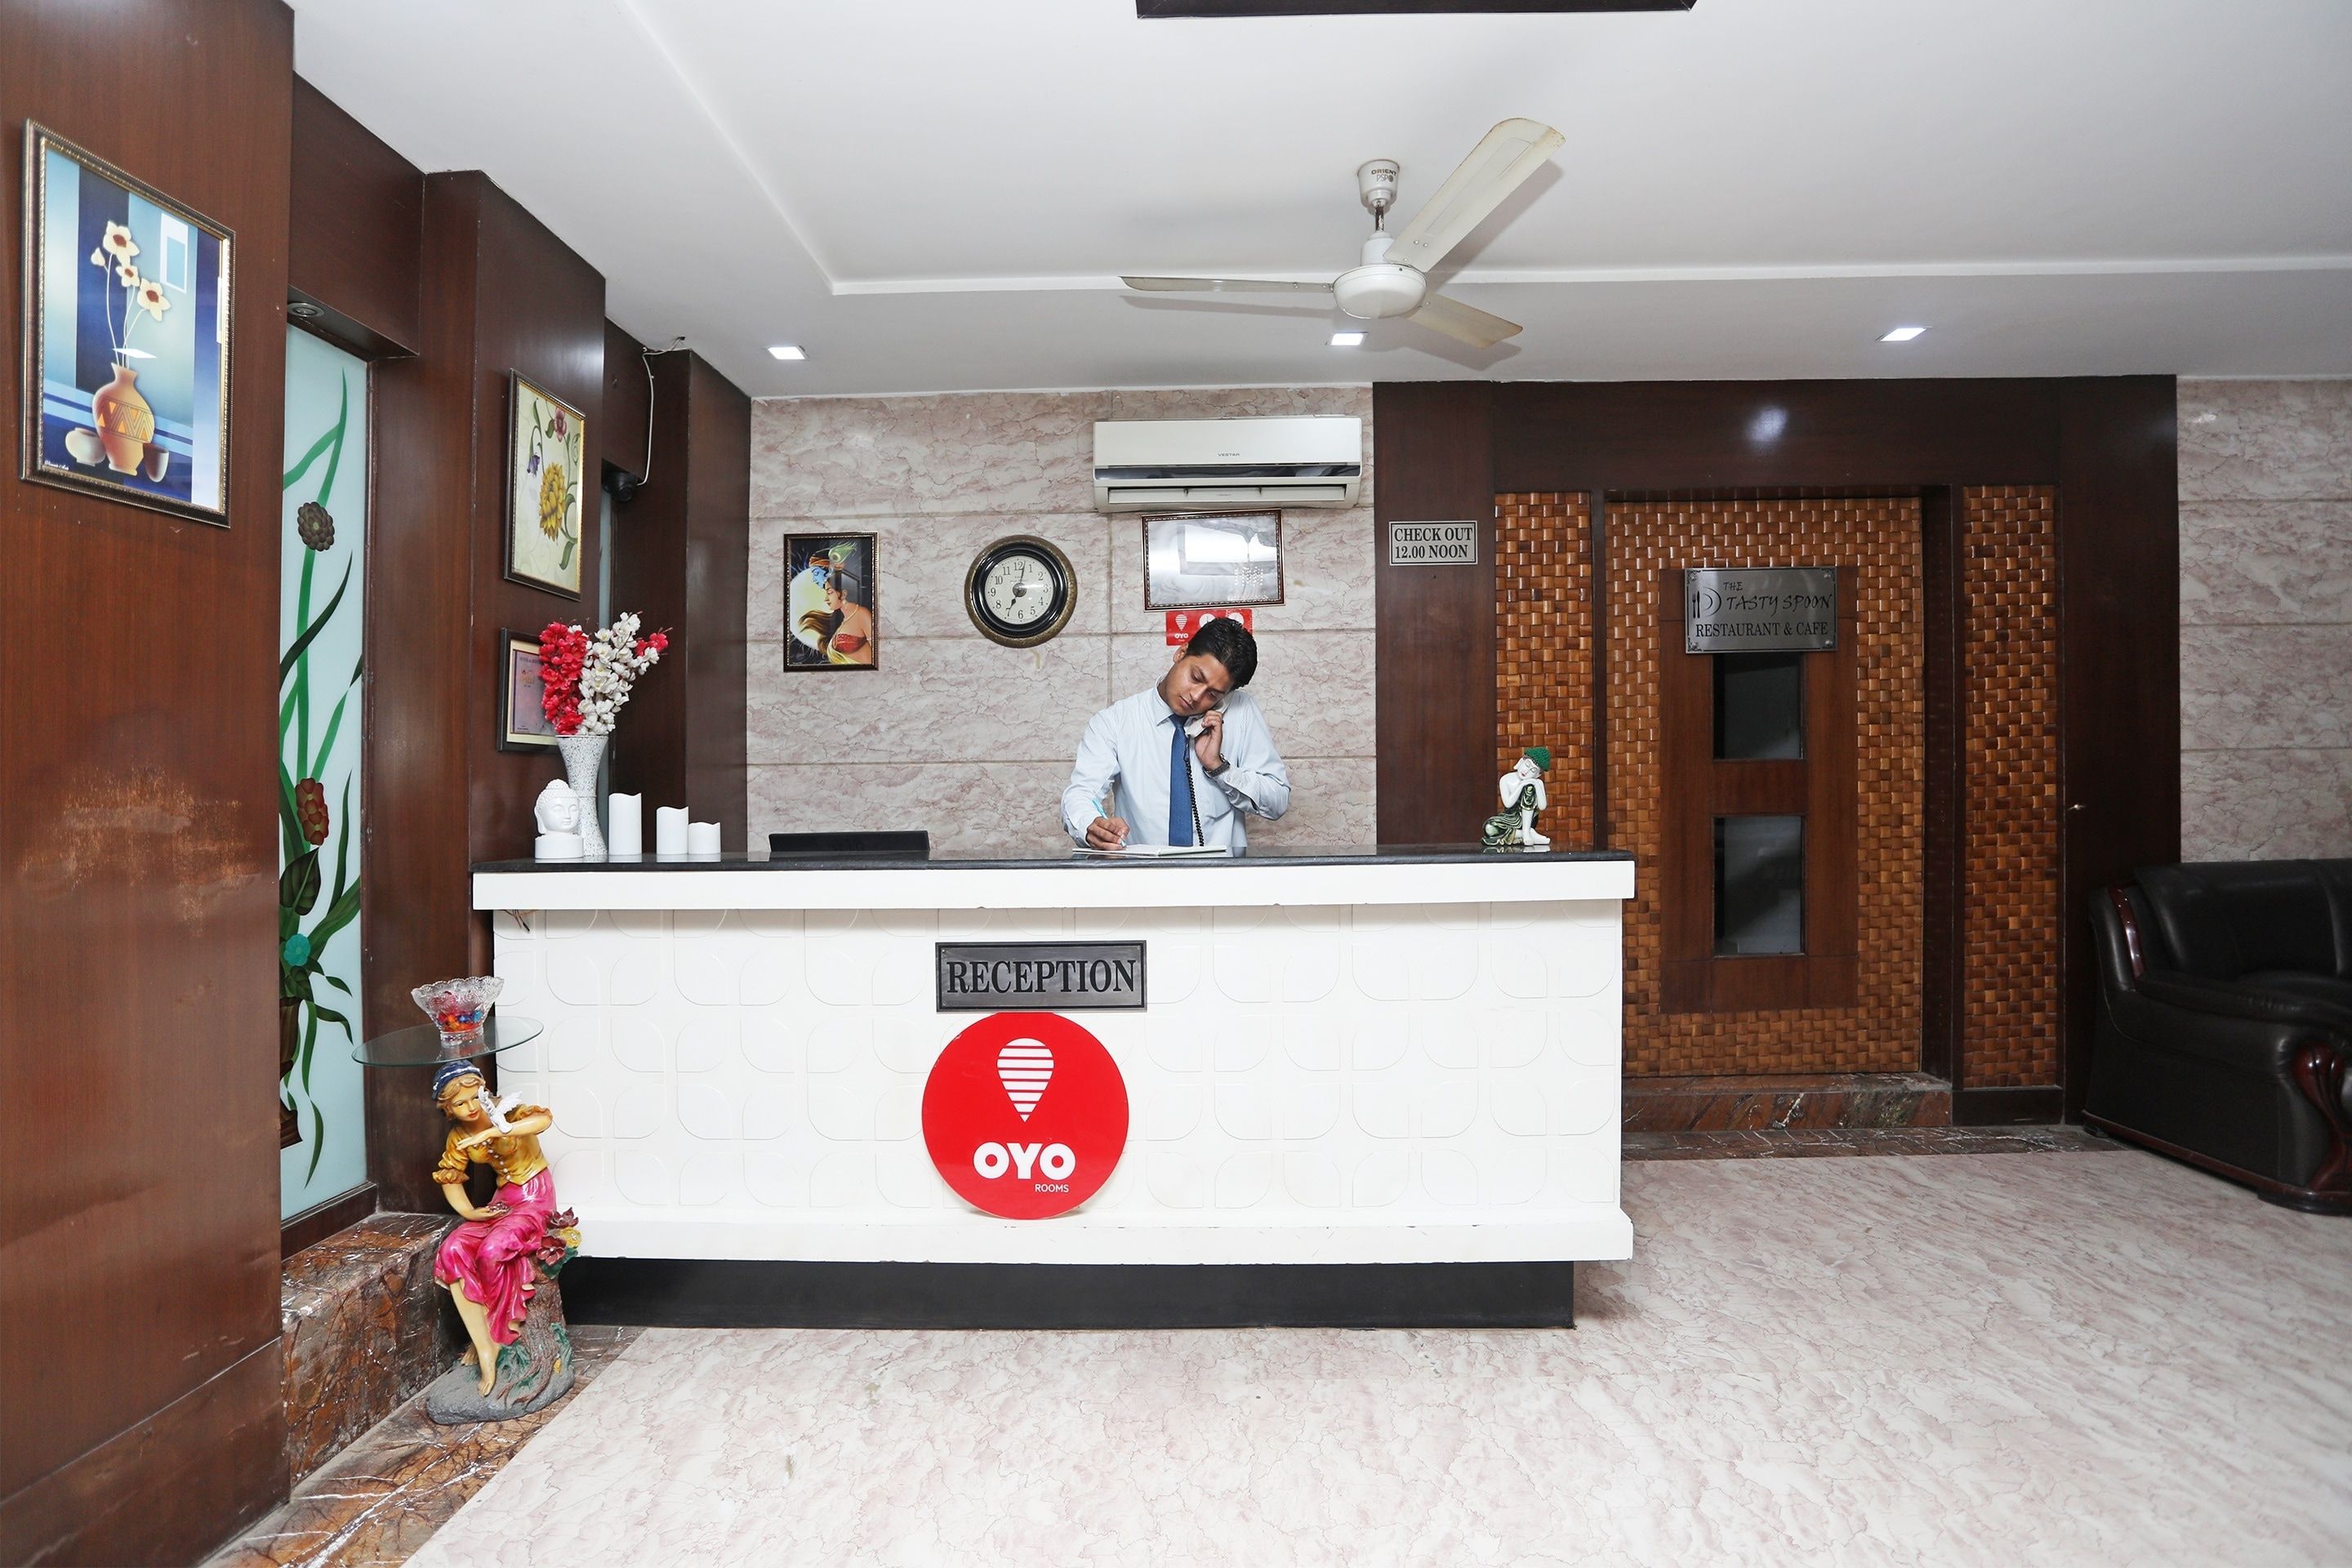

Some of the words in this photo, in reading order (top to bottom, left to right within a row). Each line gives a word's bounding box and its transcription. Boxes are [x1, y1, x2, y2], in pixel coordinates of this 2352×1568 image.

[1394, 528, 1441, 541] CHECK
[1445, 527, 1472, 541] OUT
[1395, 546, 1425, 559] 12.00
[1428, 545, 1468, 558] NOON
[1003, 566, 1011, 575] 11
[1013, 561, 1024, 571] 12
[1029, 564, 1033, 572] 1
[995, 576, 1003, 585] 10
[1038, 572, 1044, 581] 2
[1043, 584, 1049, 593] 3
[1723, 581, 1744, 590] THE
[991, 588, 996, 597] 9
[996, 600, 1001, 608] 8
[1038, 597, 1044, 605] 4
[1726, 595, 1778, 617] TASTY
[1782, 594, 1832, 612] SPOON
[1005, 608, 1011, 617] 7
[1018, 610, 1023, 619] 6
[1030, 607, 1036, 615] 5
[1695, 622, 1780, 637] RESTAURANT
[1784, 622, 1793, 635] &
[1797, 621, 1829, 635] CAFE
[946, 959, 1136, 994] RECEPTION
[973, 1142, 1076, 1181] OYO
[1035, 1184, 1070, 1193] ROOMS
